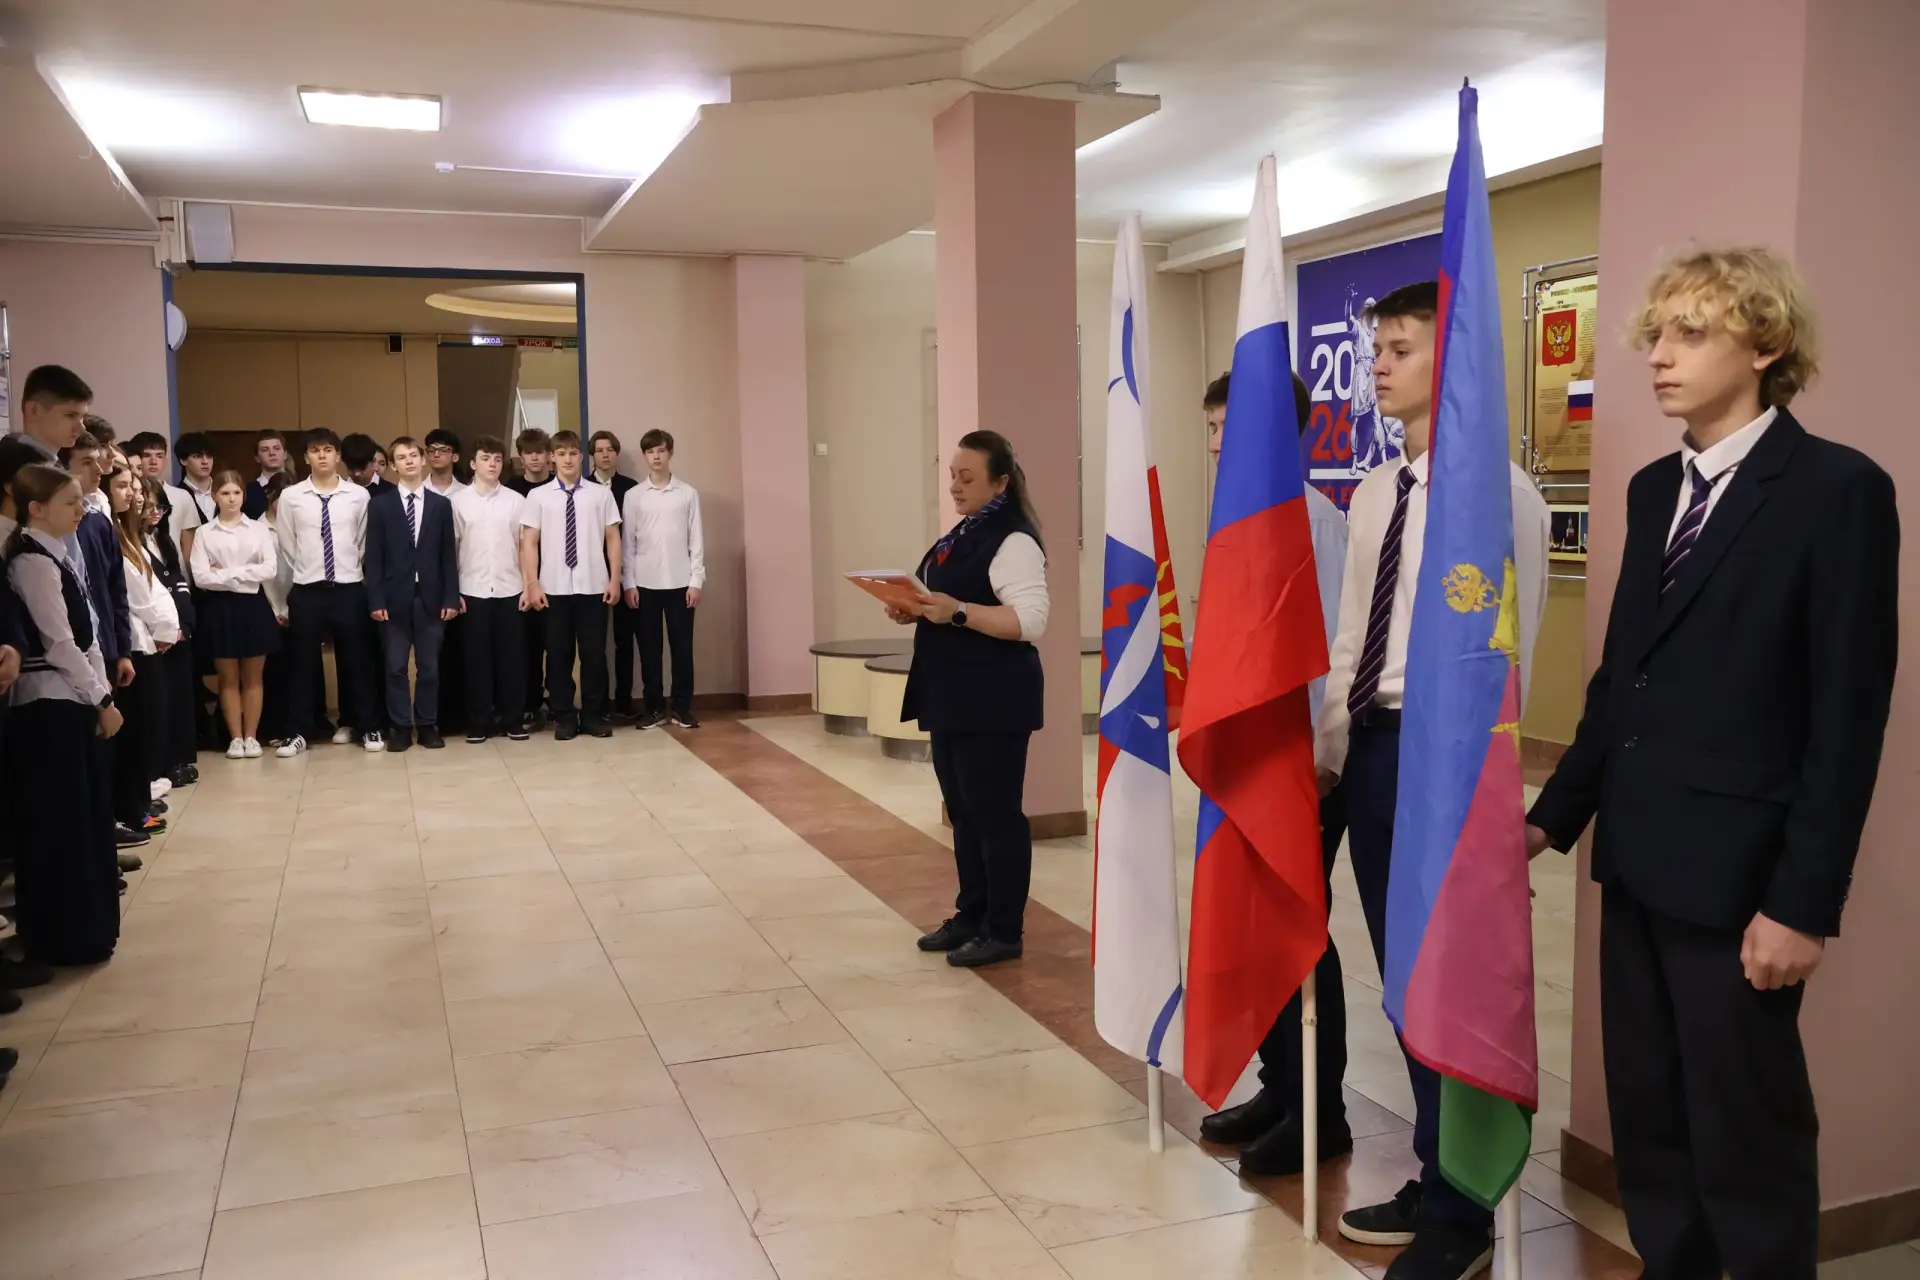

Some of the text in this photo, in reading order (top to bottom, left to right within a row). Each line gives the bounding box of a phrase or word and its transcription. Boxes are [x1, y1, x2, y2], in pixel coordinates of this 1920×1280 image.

[472, 335, 501, 344] ЫХОД
[523, 339, 547, 347] УРОК
[1310, 340, 1353, 402] 20
[1309, 402, 1353, 461] 26
